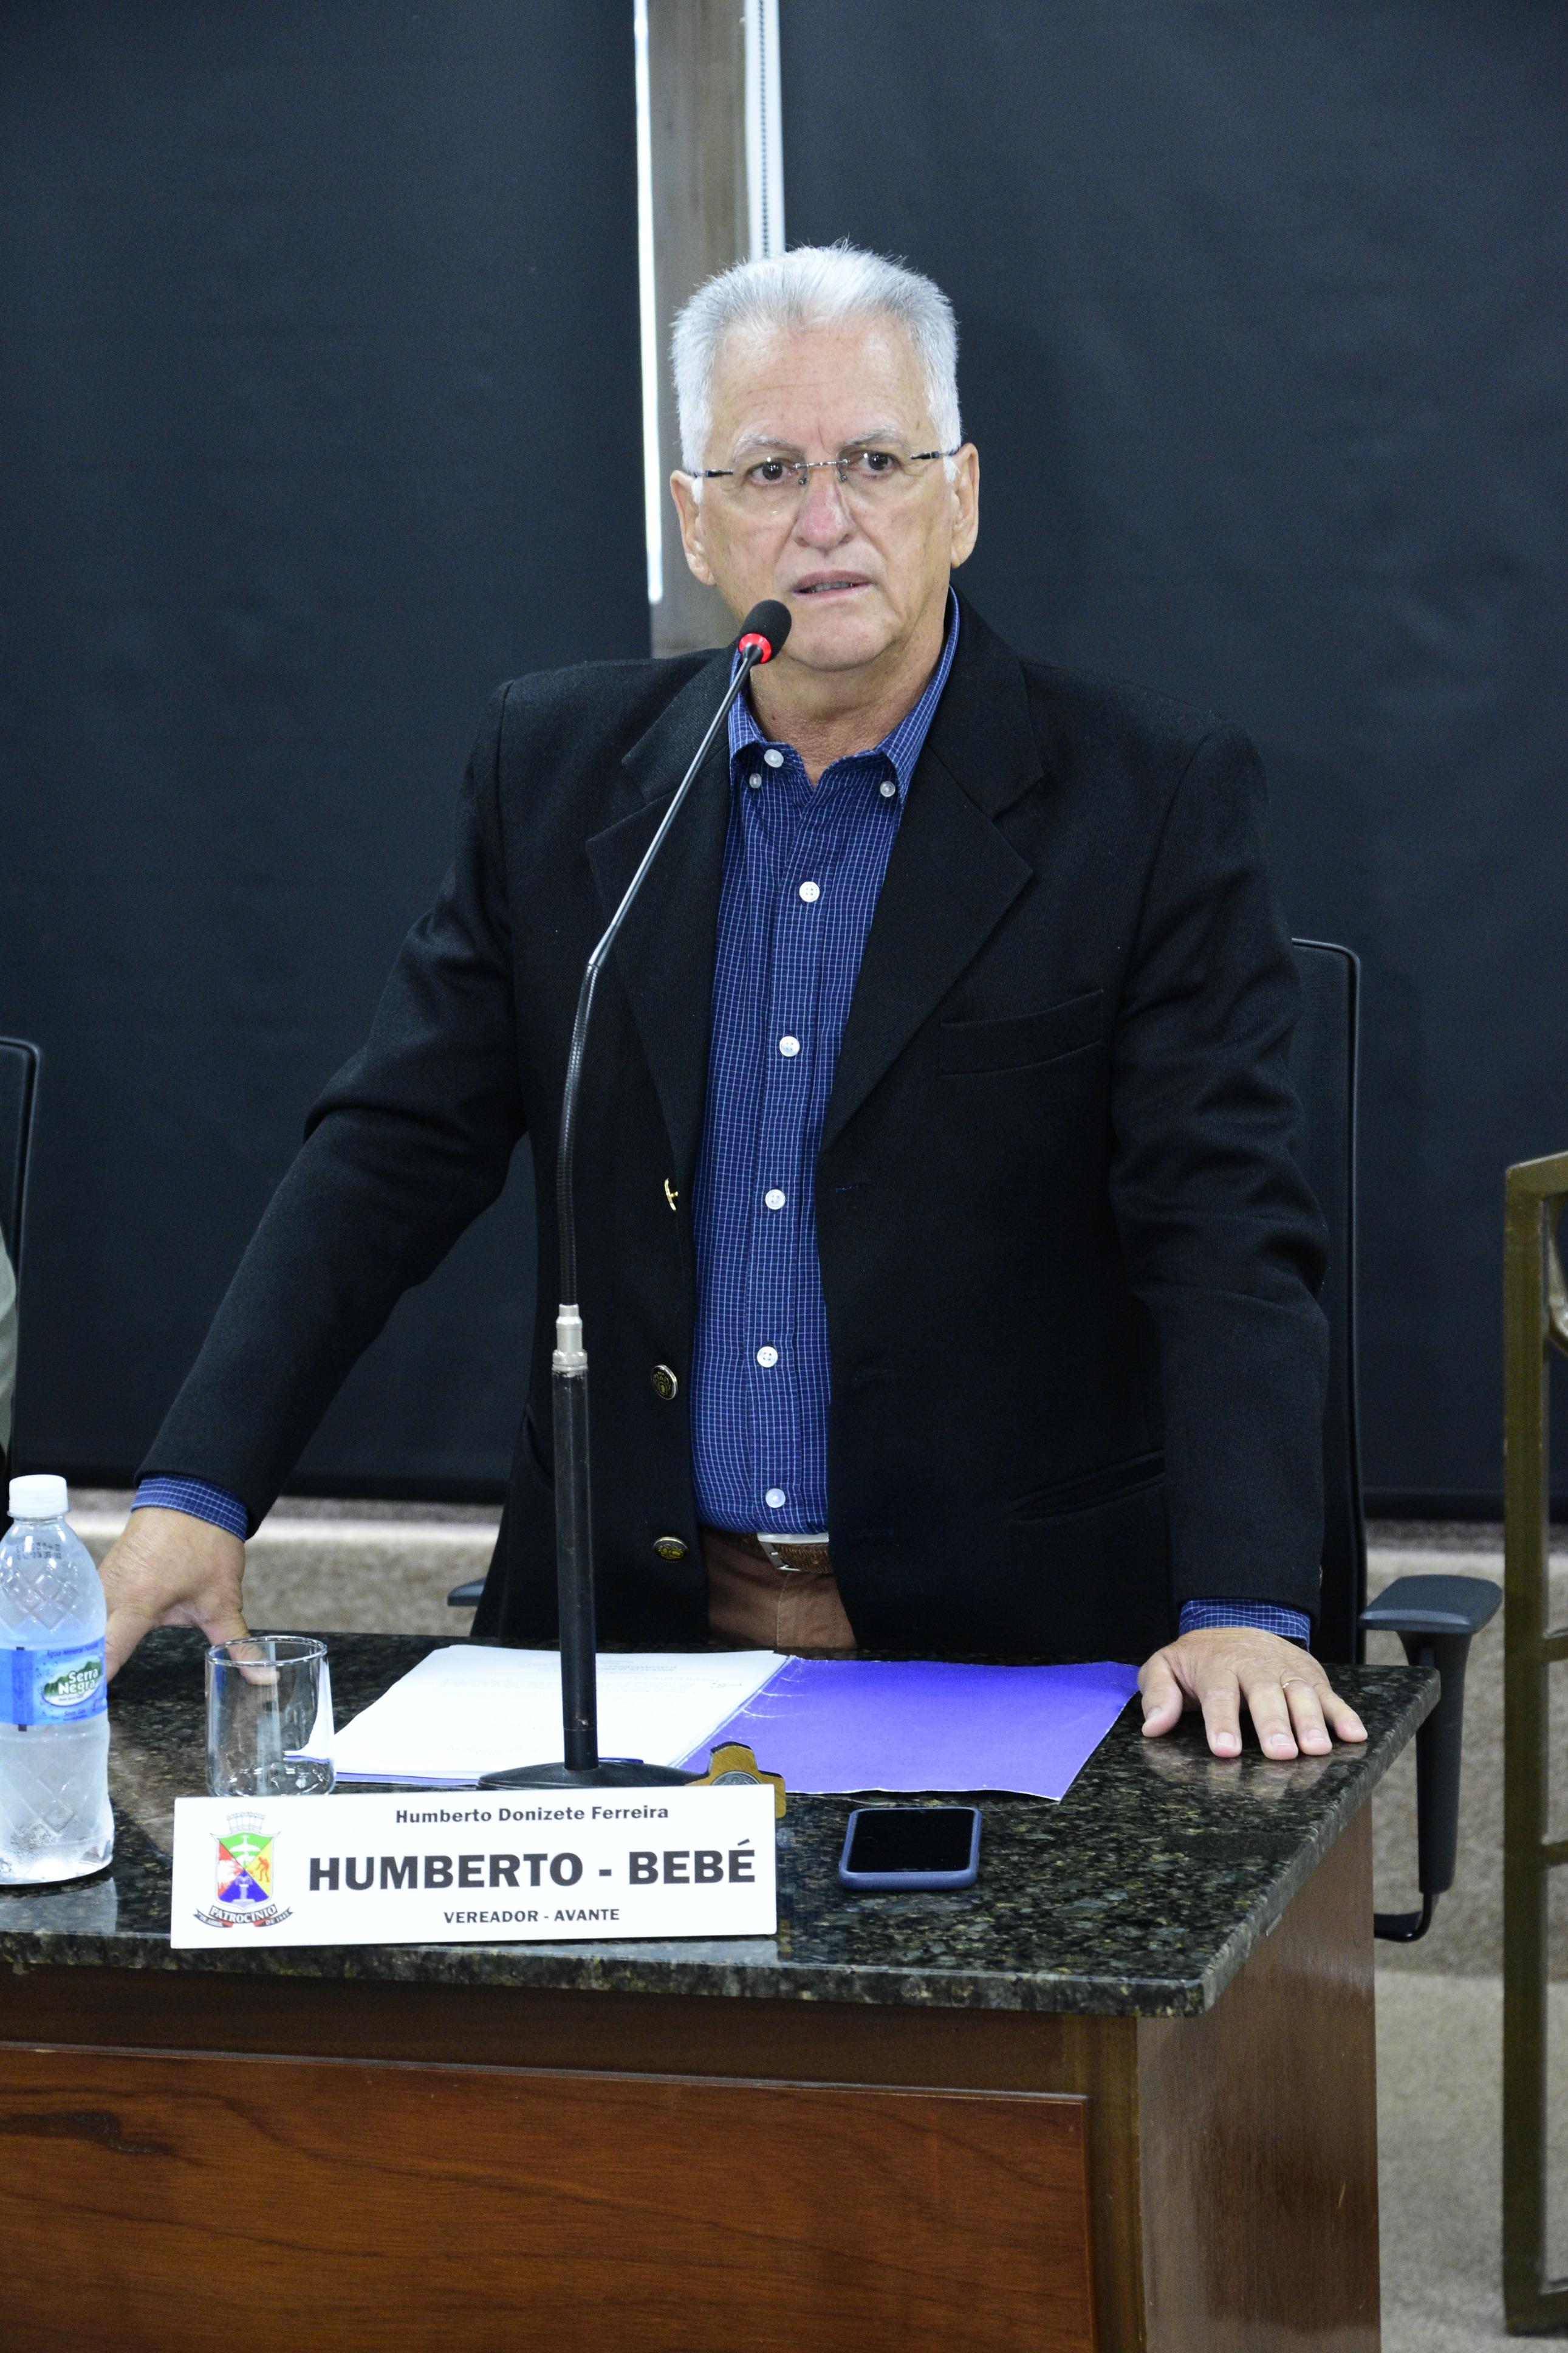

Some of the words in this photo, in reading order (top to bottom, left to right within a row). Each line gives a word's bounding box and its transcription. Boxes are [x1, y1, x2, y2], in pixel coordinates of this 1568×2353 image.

[68, 1668, 98, 1684] Serra
[57, 1679, 96, 1695] Negra
[396, 1810, 491, 1823] Humberto
[499, 1807, 584, 1822] Donizete
[592, 1805, 668, 1819] Ferreira
[309, 1852, 583, 1891] HUMBERTO
[629, 1839, 755, 1884] BEBÉ
[444, 1910, 538, 1924] VEREADOR
[554, 1909, 619, 1922] AVANTE
